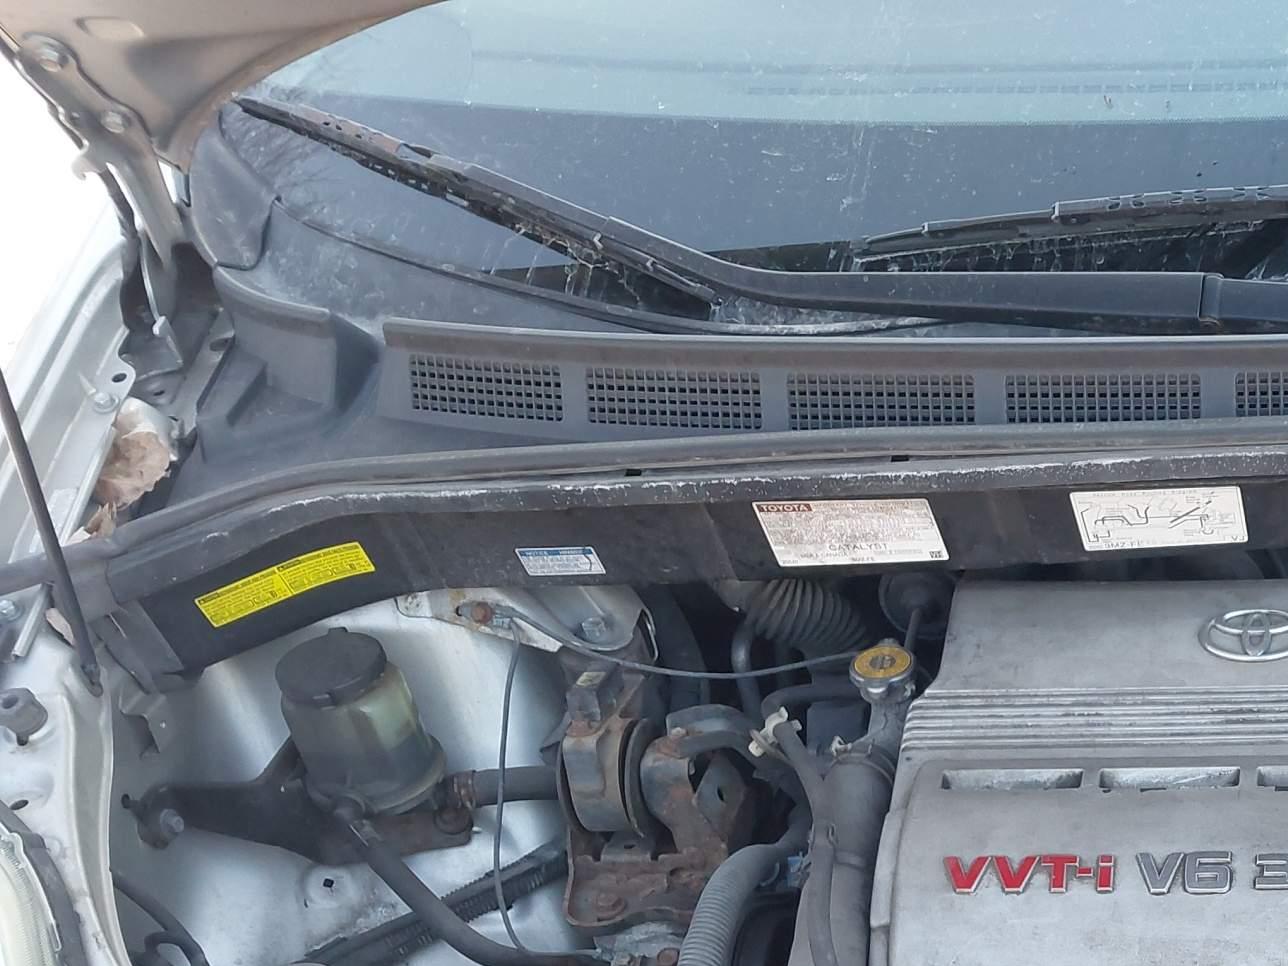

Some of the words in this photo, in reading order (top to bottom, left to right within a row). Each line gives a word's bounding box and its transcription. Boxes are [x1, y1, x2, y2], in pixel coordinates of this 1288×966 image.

[760, 504, 808, 512] TOYOTA
[828, 542, 888, 551] CATALYST
[943, 855, 1115, 895] VVT-i
[1135, 851, 1233, 896] V6
